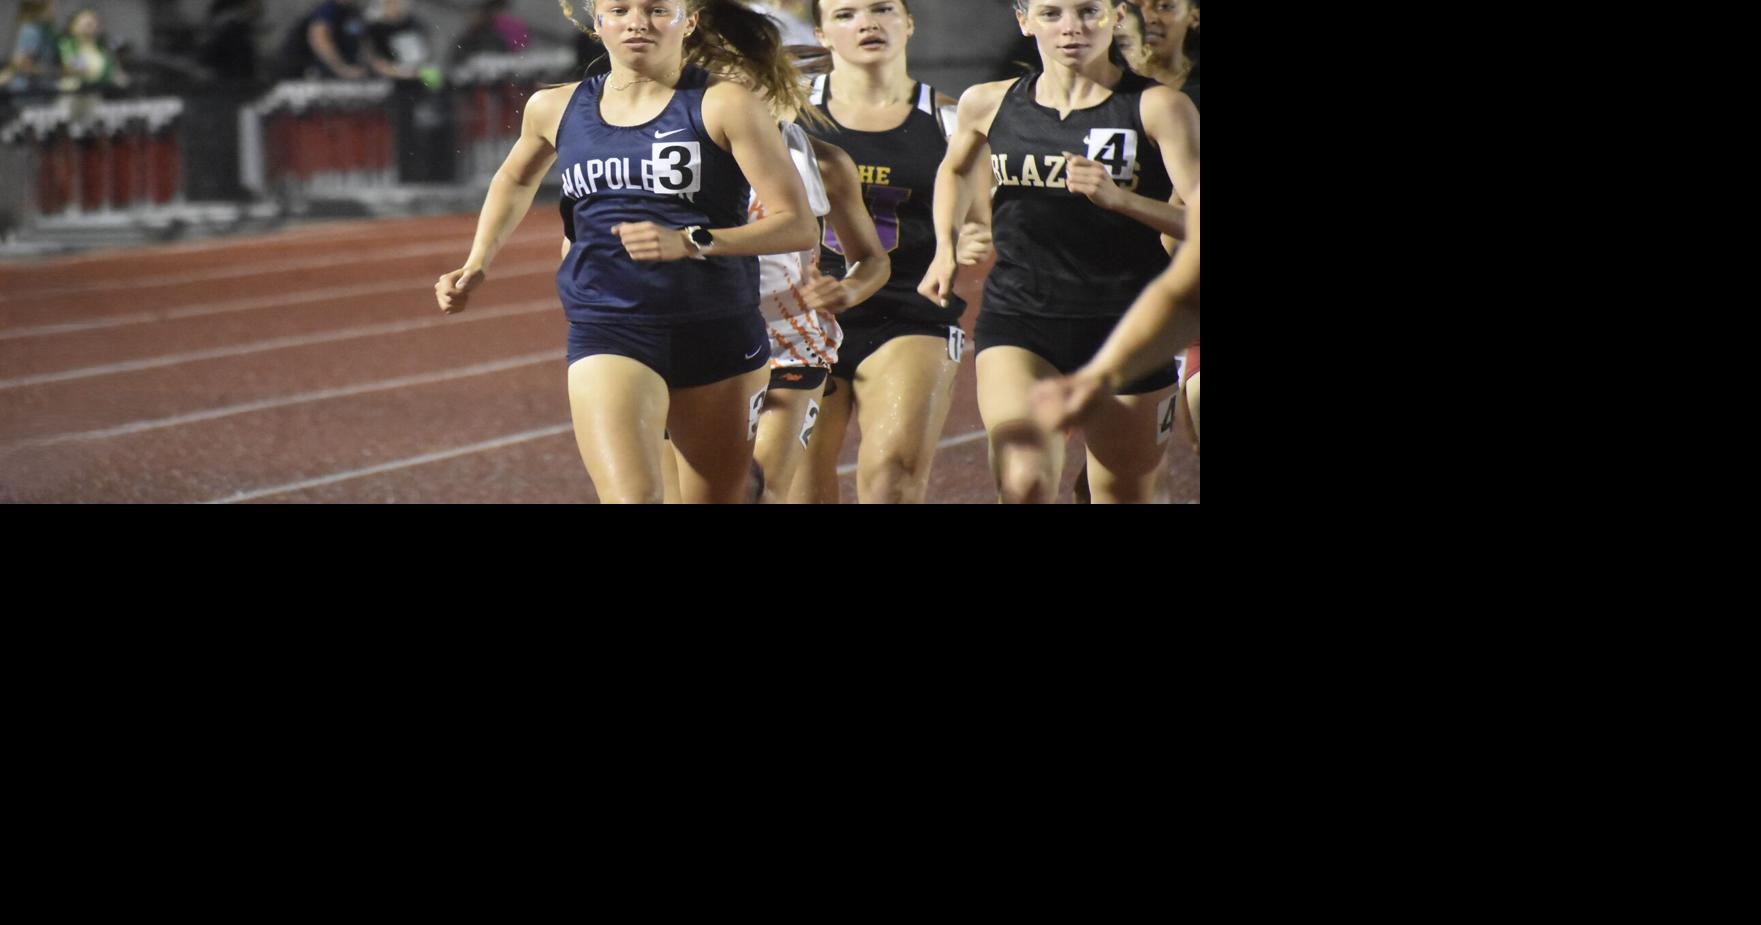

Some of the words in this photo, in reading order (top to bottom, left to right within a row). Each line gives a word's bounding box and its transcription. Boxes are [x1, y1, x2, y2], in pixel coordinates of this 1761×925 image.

[659, 146, 694, 190] 3
[1094, 133, 1128, 175] 4
[857, 165, 891, 185] HE
[1161, 395, 1176, 432] 4
